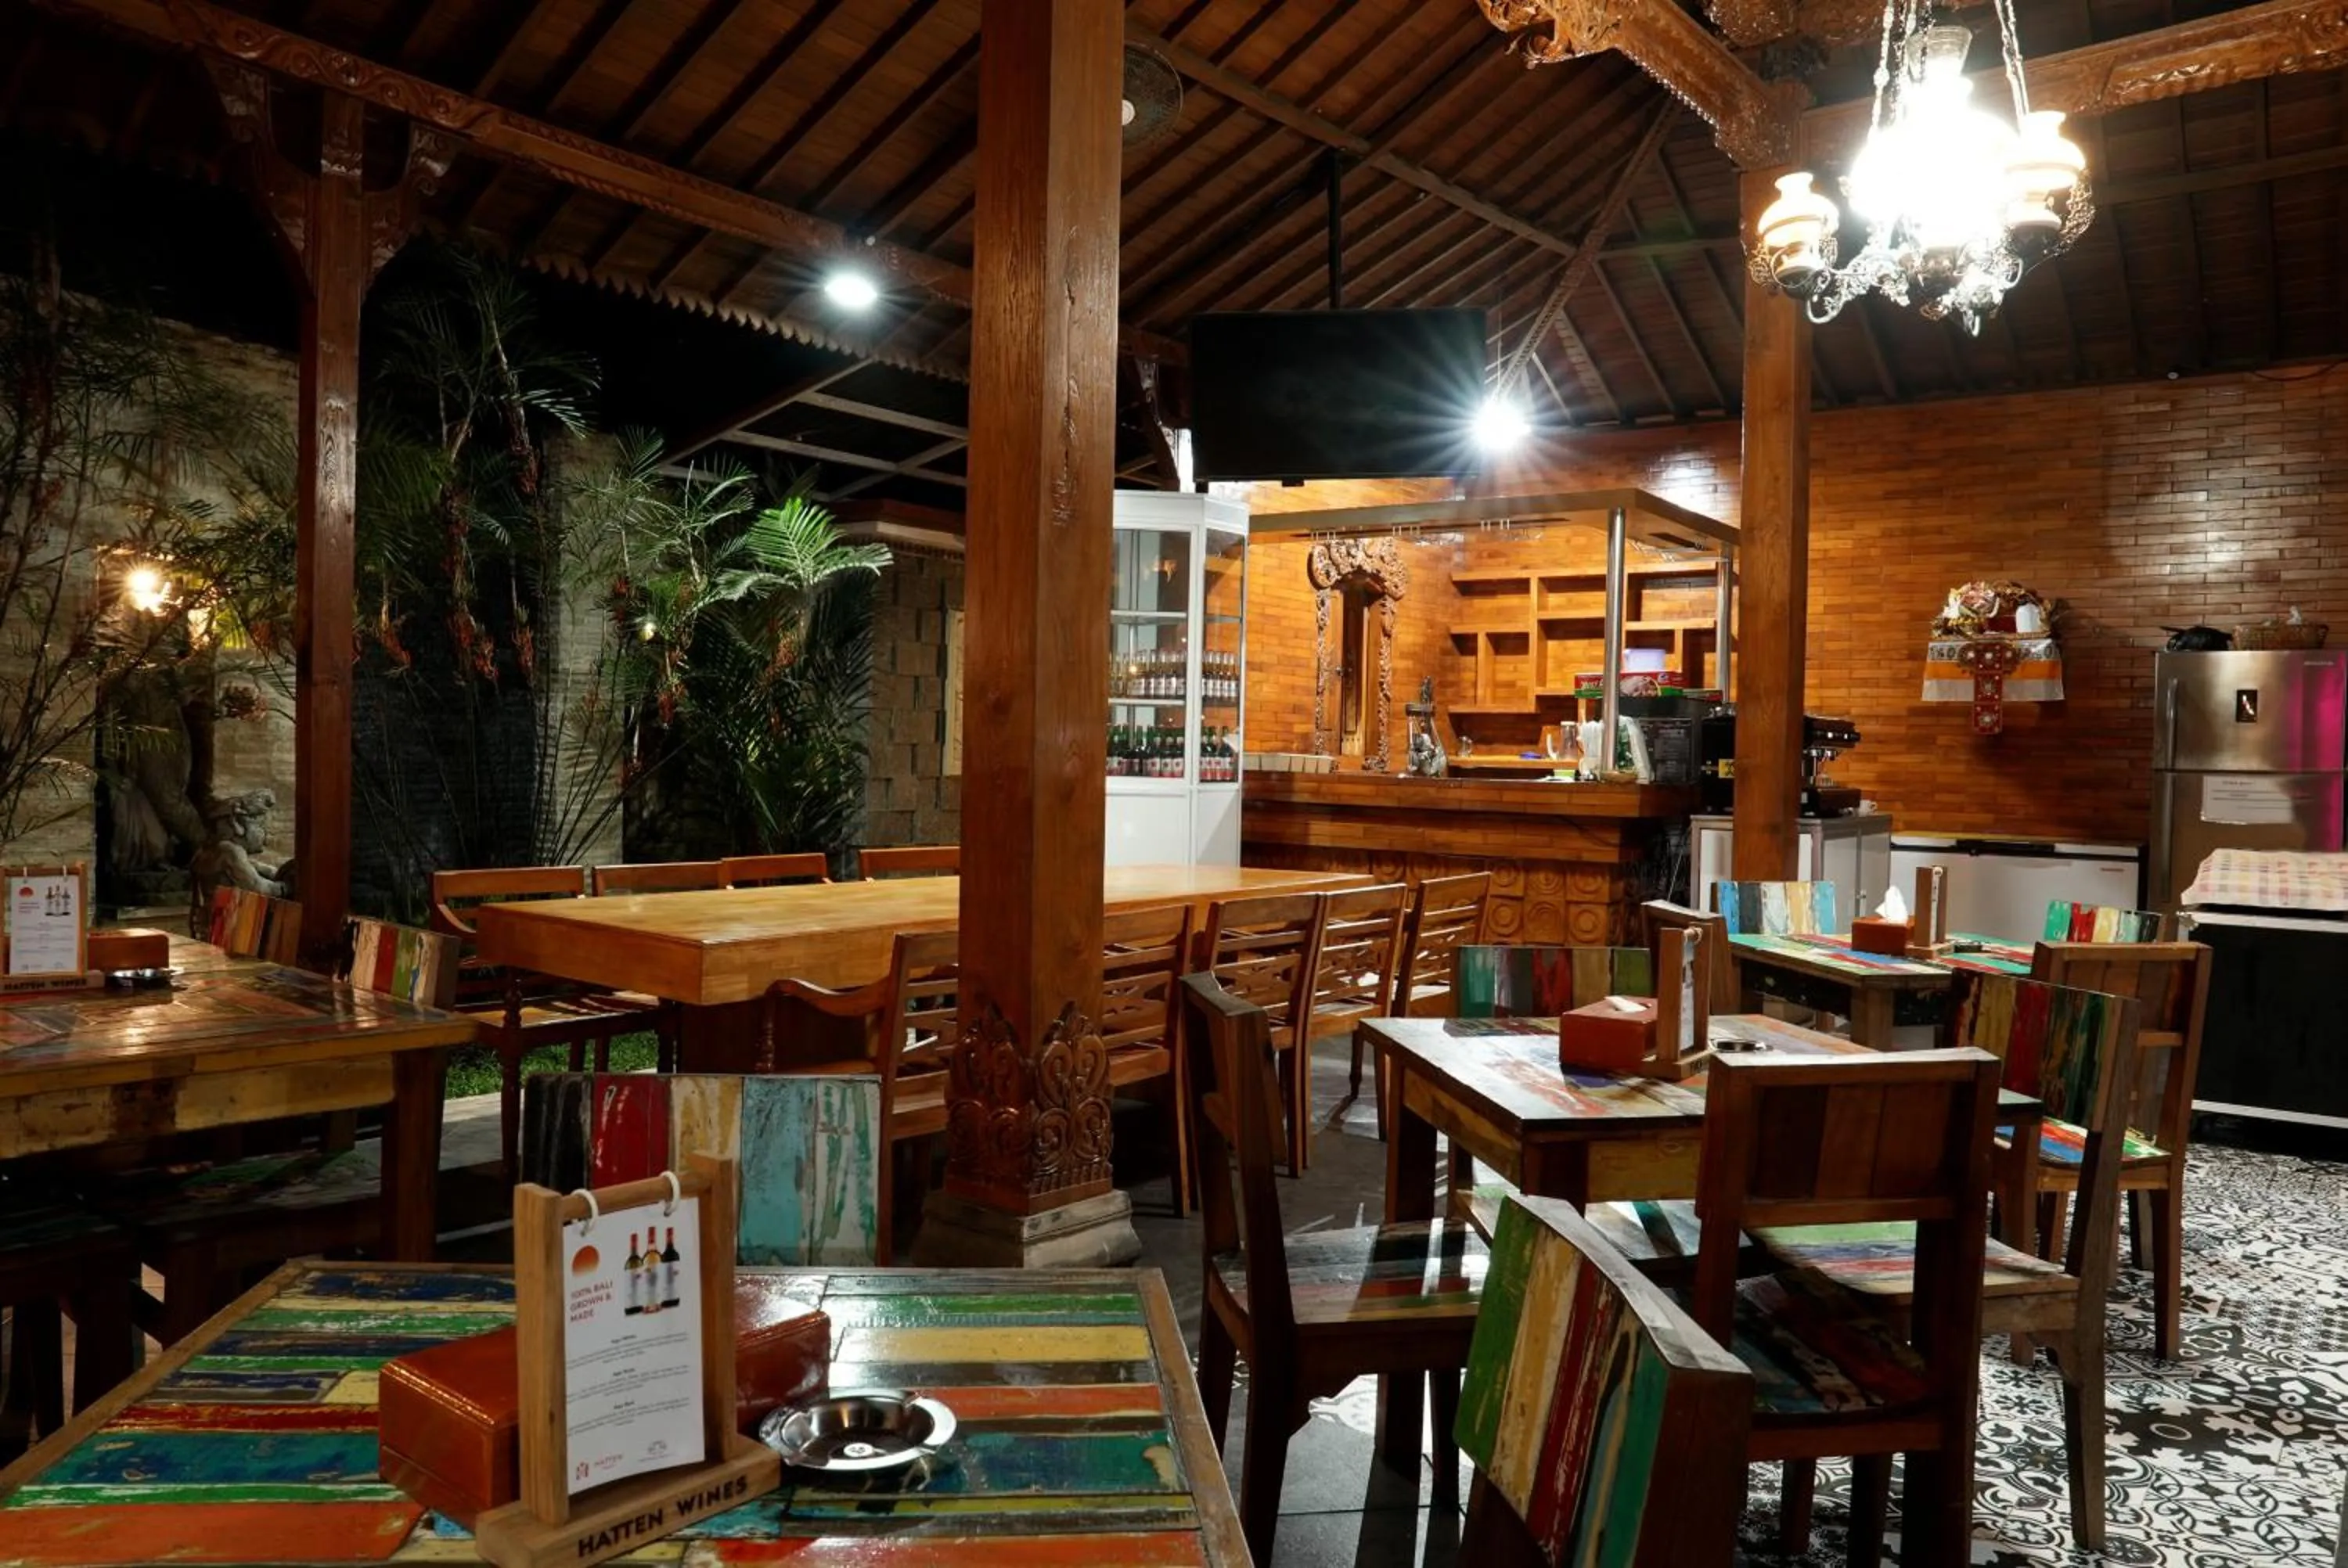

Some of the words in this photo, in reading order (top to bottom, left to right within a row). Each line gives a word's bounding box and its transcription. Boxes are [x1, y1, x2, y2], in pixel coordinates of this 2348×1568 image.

[593, 1280, 613, 1292] BALI
[570, 1294, 603, 1311] GROWN
[570, 1308, 594, 1322] MADE
[578, 1508, 664, 1558] HATTEN
[676, 1474, 747, 1516] WINES
